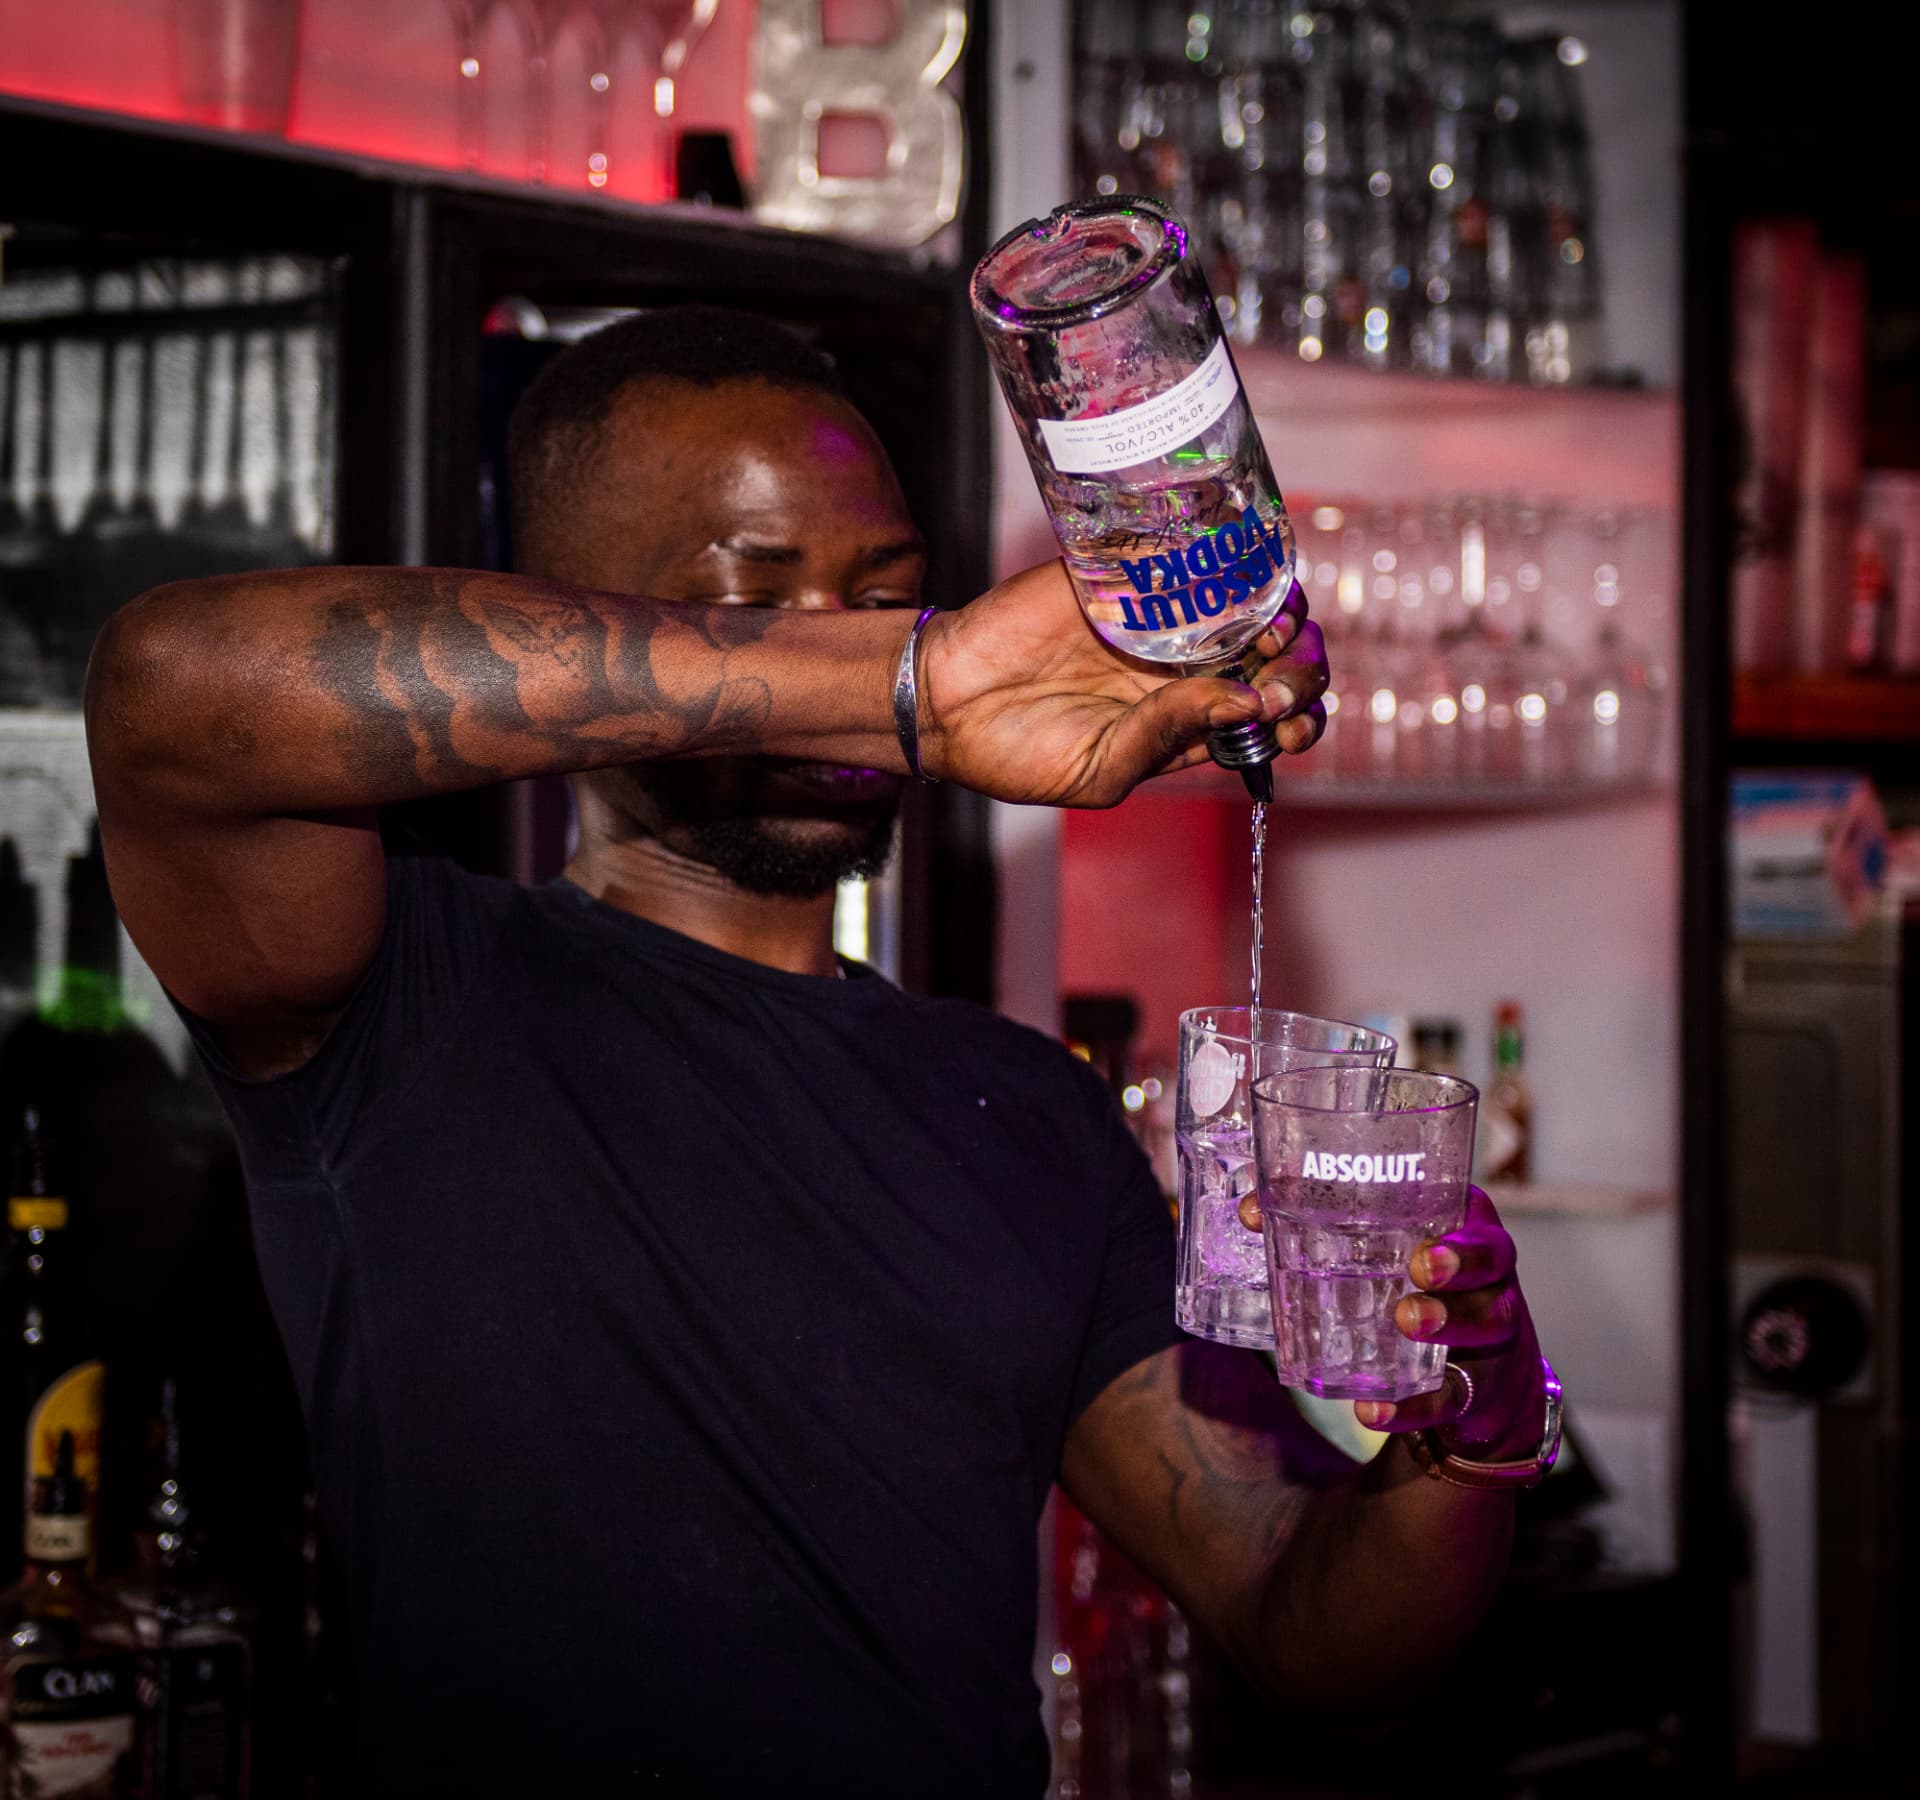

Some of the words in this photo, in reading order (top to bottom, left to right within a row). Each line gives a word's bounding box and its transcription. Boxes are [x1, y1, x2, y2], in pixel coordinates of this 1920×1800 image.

[1106, 422, 1175, 454] ALC/VOL
[1128, 405, 1181, 432] IMPORTED
[1119, 504, 1268, 594] VODKA
[1119, 522, 1285, 631] ABSOLUT
